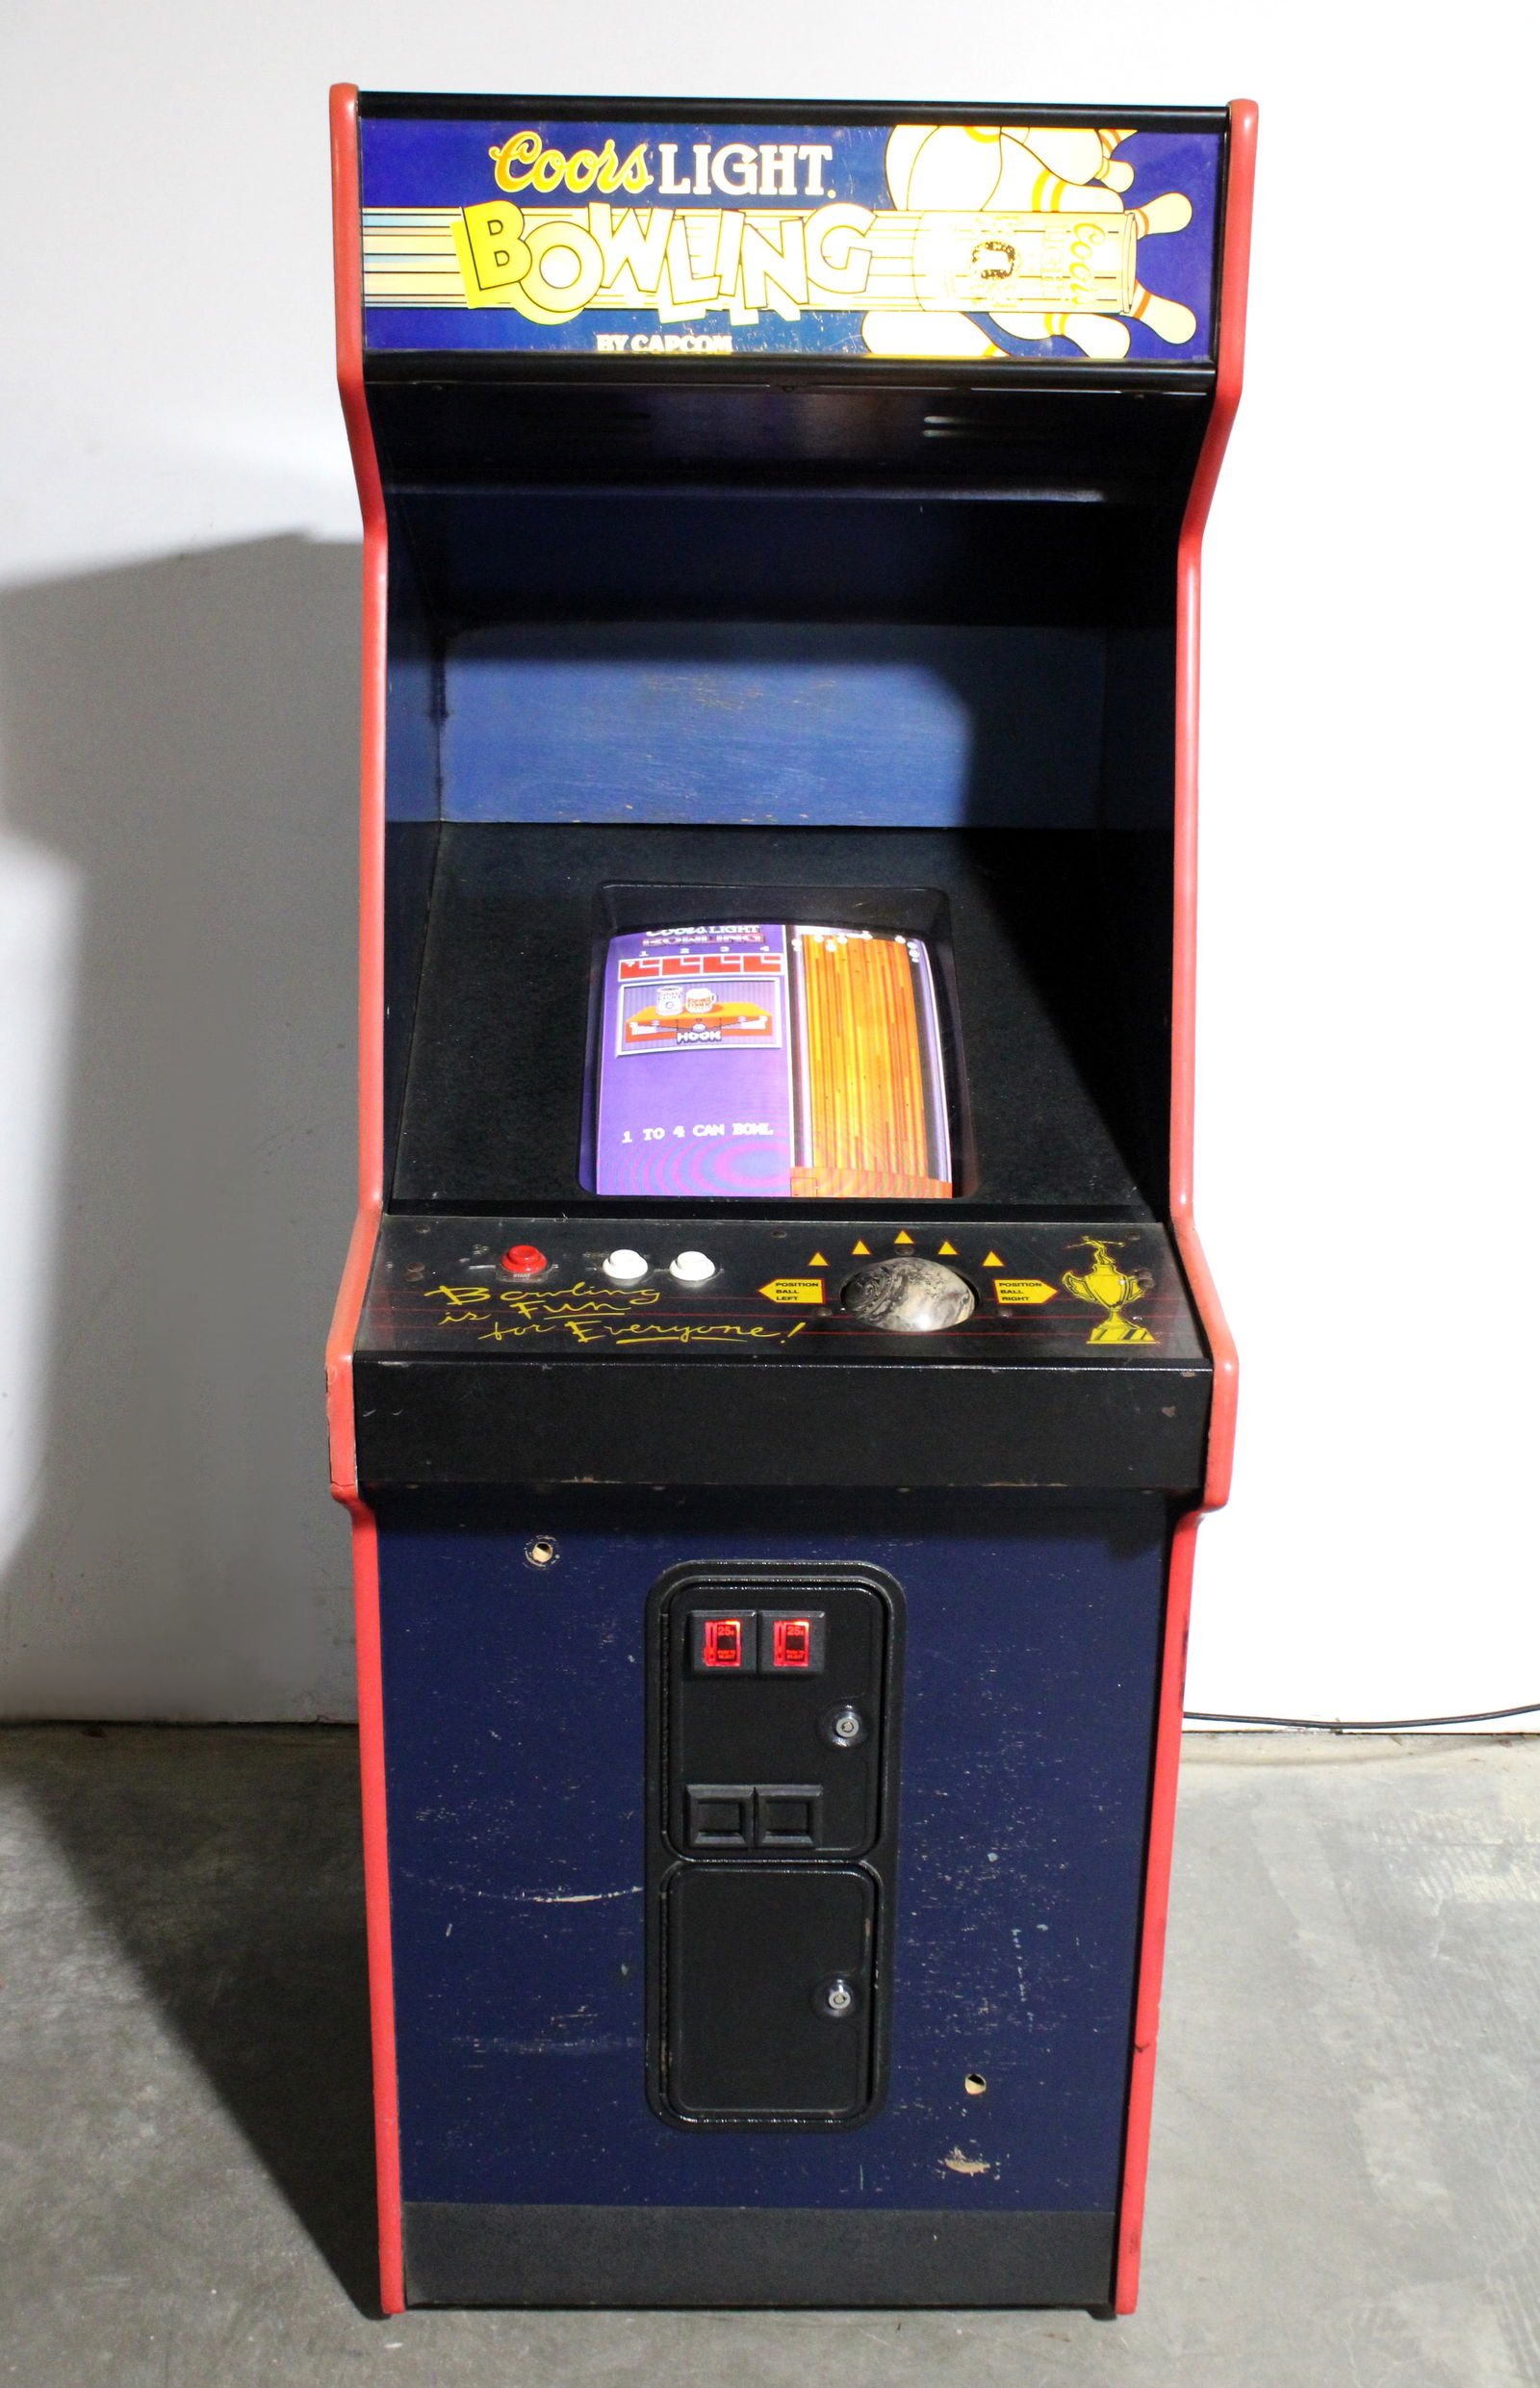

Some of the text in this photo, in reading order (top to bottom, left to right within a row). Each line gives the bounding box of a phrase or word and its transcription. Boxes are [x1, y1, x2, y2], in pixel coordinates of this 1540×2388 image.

[488, 131, 654, 193] Coors
[452, 200, 877, 324] BOWLING
[597, 334, 733, 355] BY CAPCOM
[677, 1031, 722, 1043] HOOK
[622, 1131, 632, 1143] 1
[643, 1127, 665, 1141] TO
[673, 1125, 685, 1138] 4
[693, 1124, 725, 1137] CAN
[424, 1281, 660, 1304] Bowling
[438, 1299, 631, 1325] is Fun
[478, 1321, 555, 1341] for
